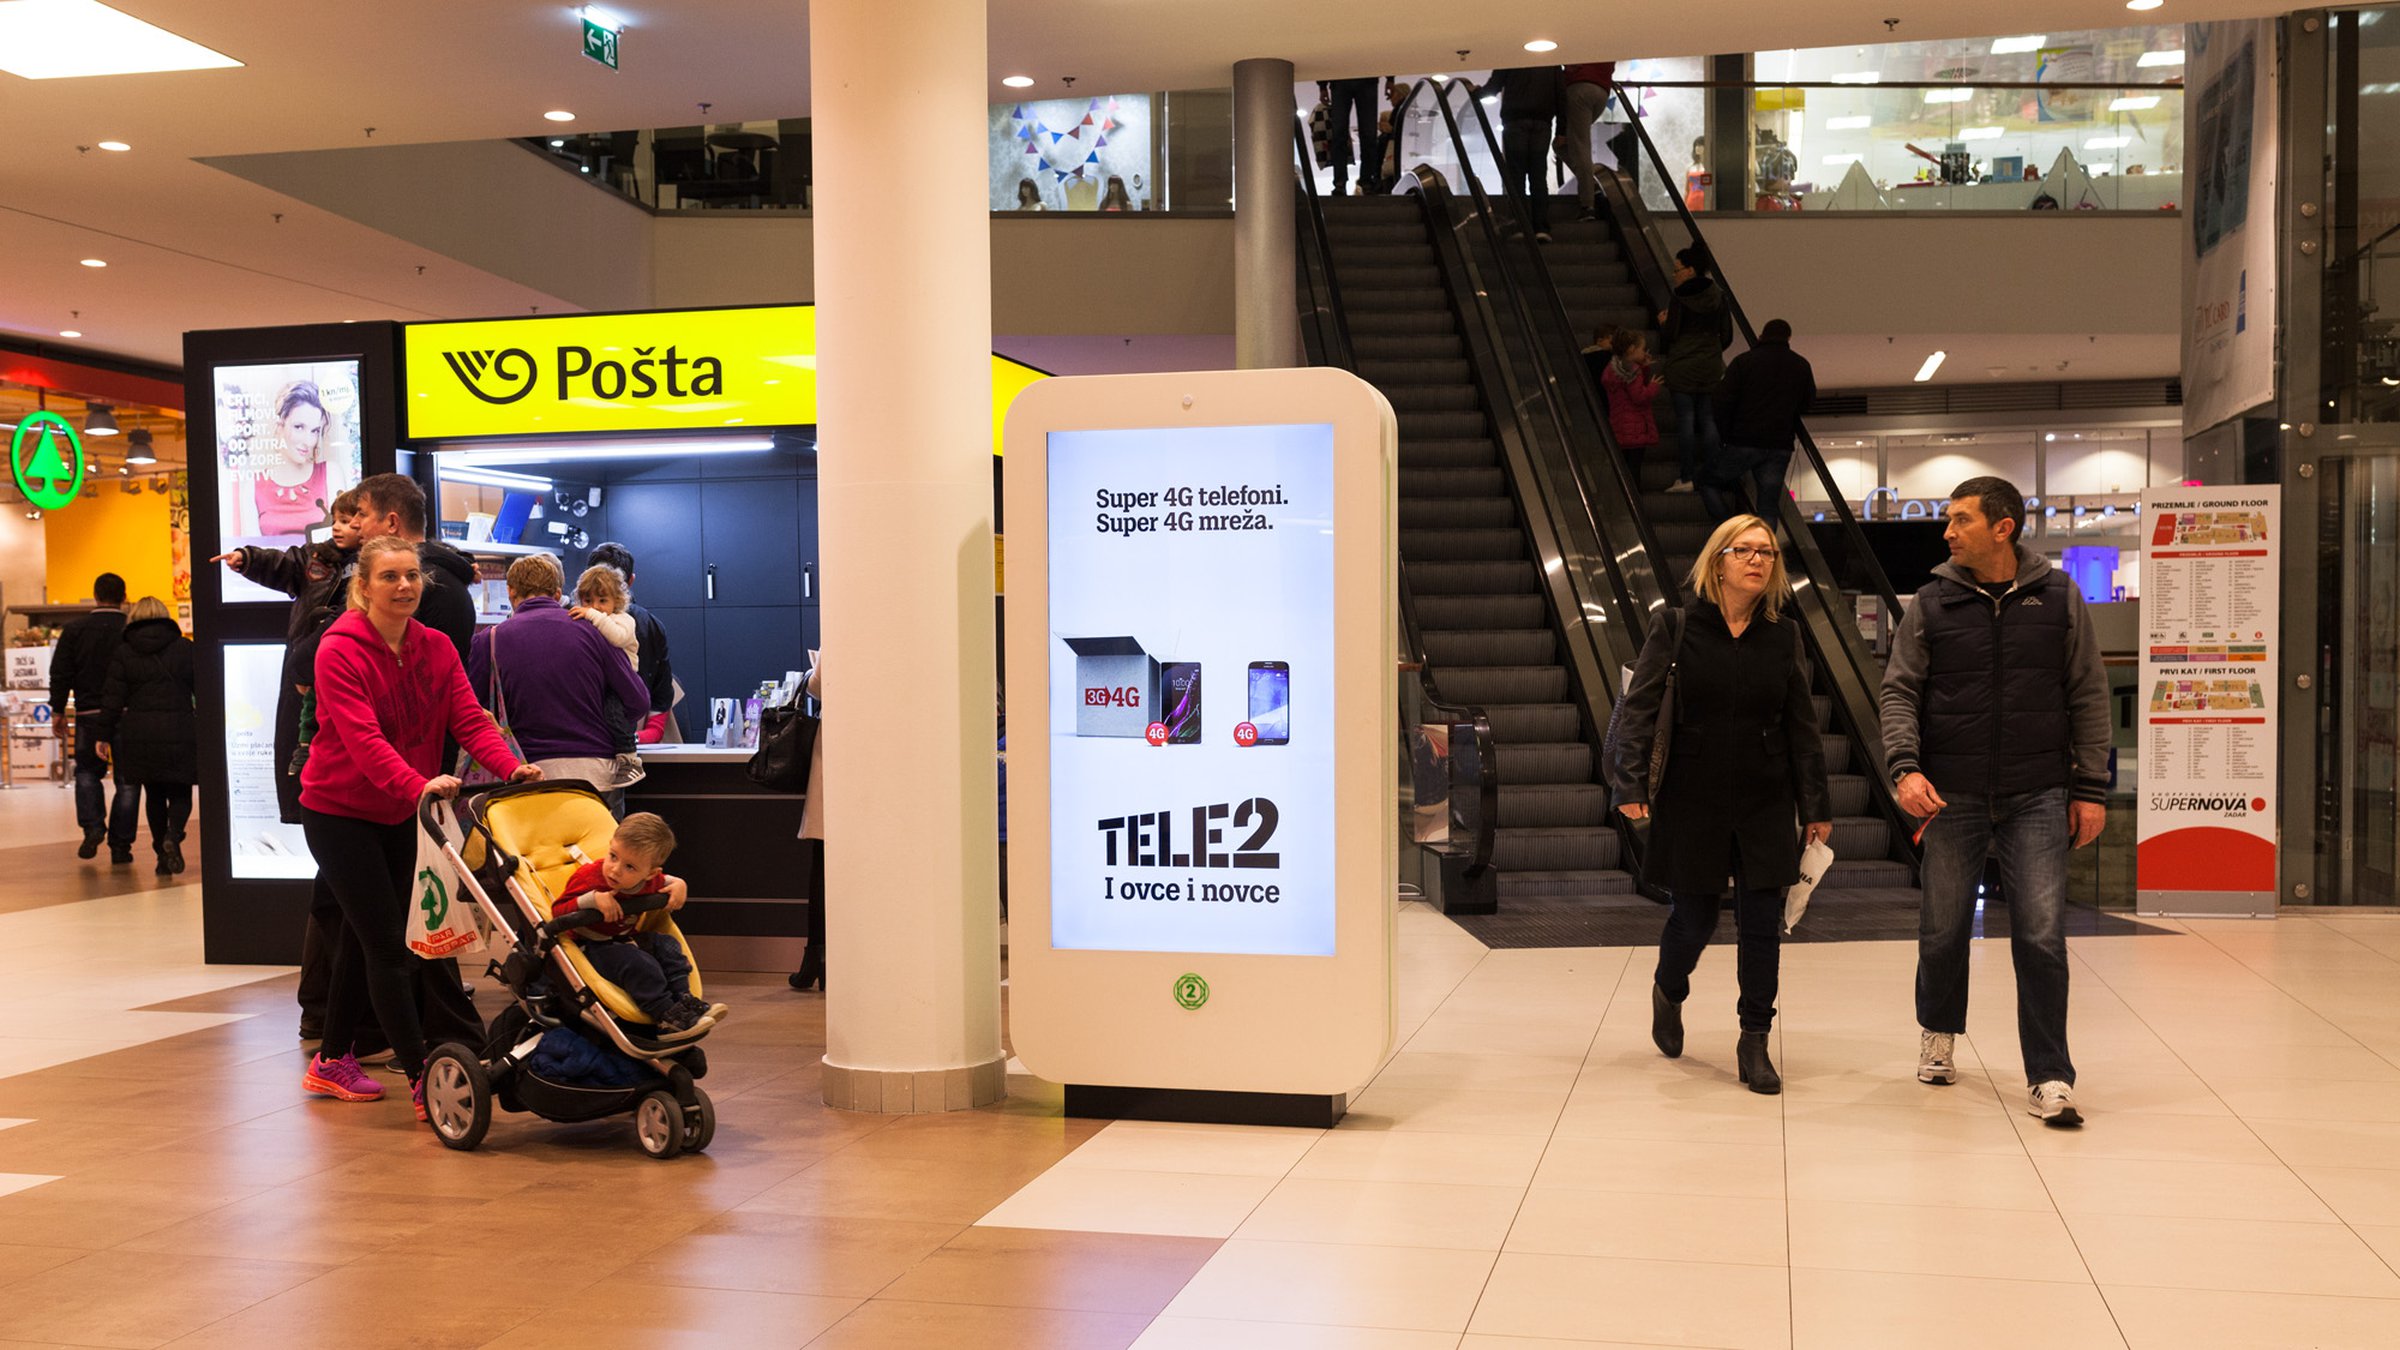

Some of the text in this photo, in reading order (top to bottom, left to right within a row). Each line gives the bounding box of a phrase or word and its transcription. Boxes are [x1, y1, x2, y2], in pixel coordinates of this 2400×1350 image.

[557, 345, 723, 401] Pošta
[228, 438, 288, 452] OD JUTRA
[229, 454, 247, 467] DO
[1096, 485, 1288, 512] Super 4G telefoni.
[2152, 501, 2195, 509] PRIZEMLJE
[1096, 509, 1274, 537] Super 4G mreža.
[1087, 687, 1140, 707] 3G 4G
[1149, 728, 1165, 739] 4G
[1236, 728, 1253, 739] 4G
[2150, 798, 2247, 811] SUPERNOVA
[1098, 797, 1280, 869] TELE2
[1105, 877, 1280, 904] I ovce i novce
[1186, 983, 1196, 998] 2
